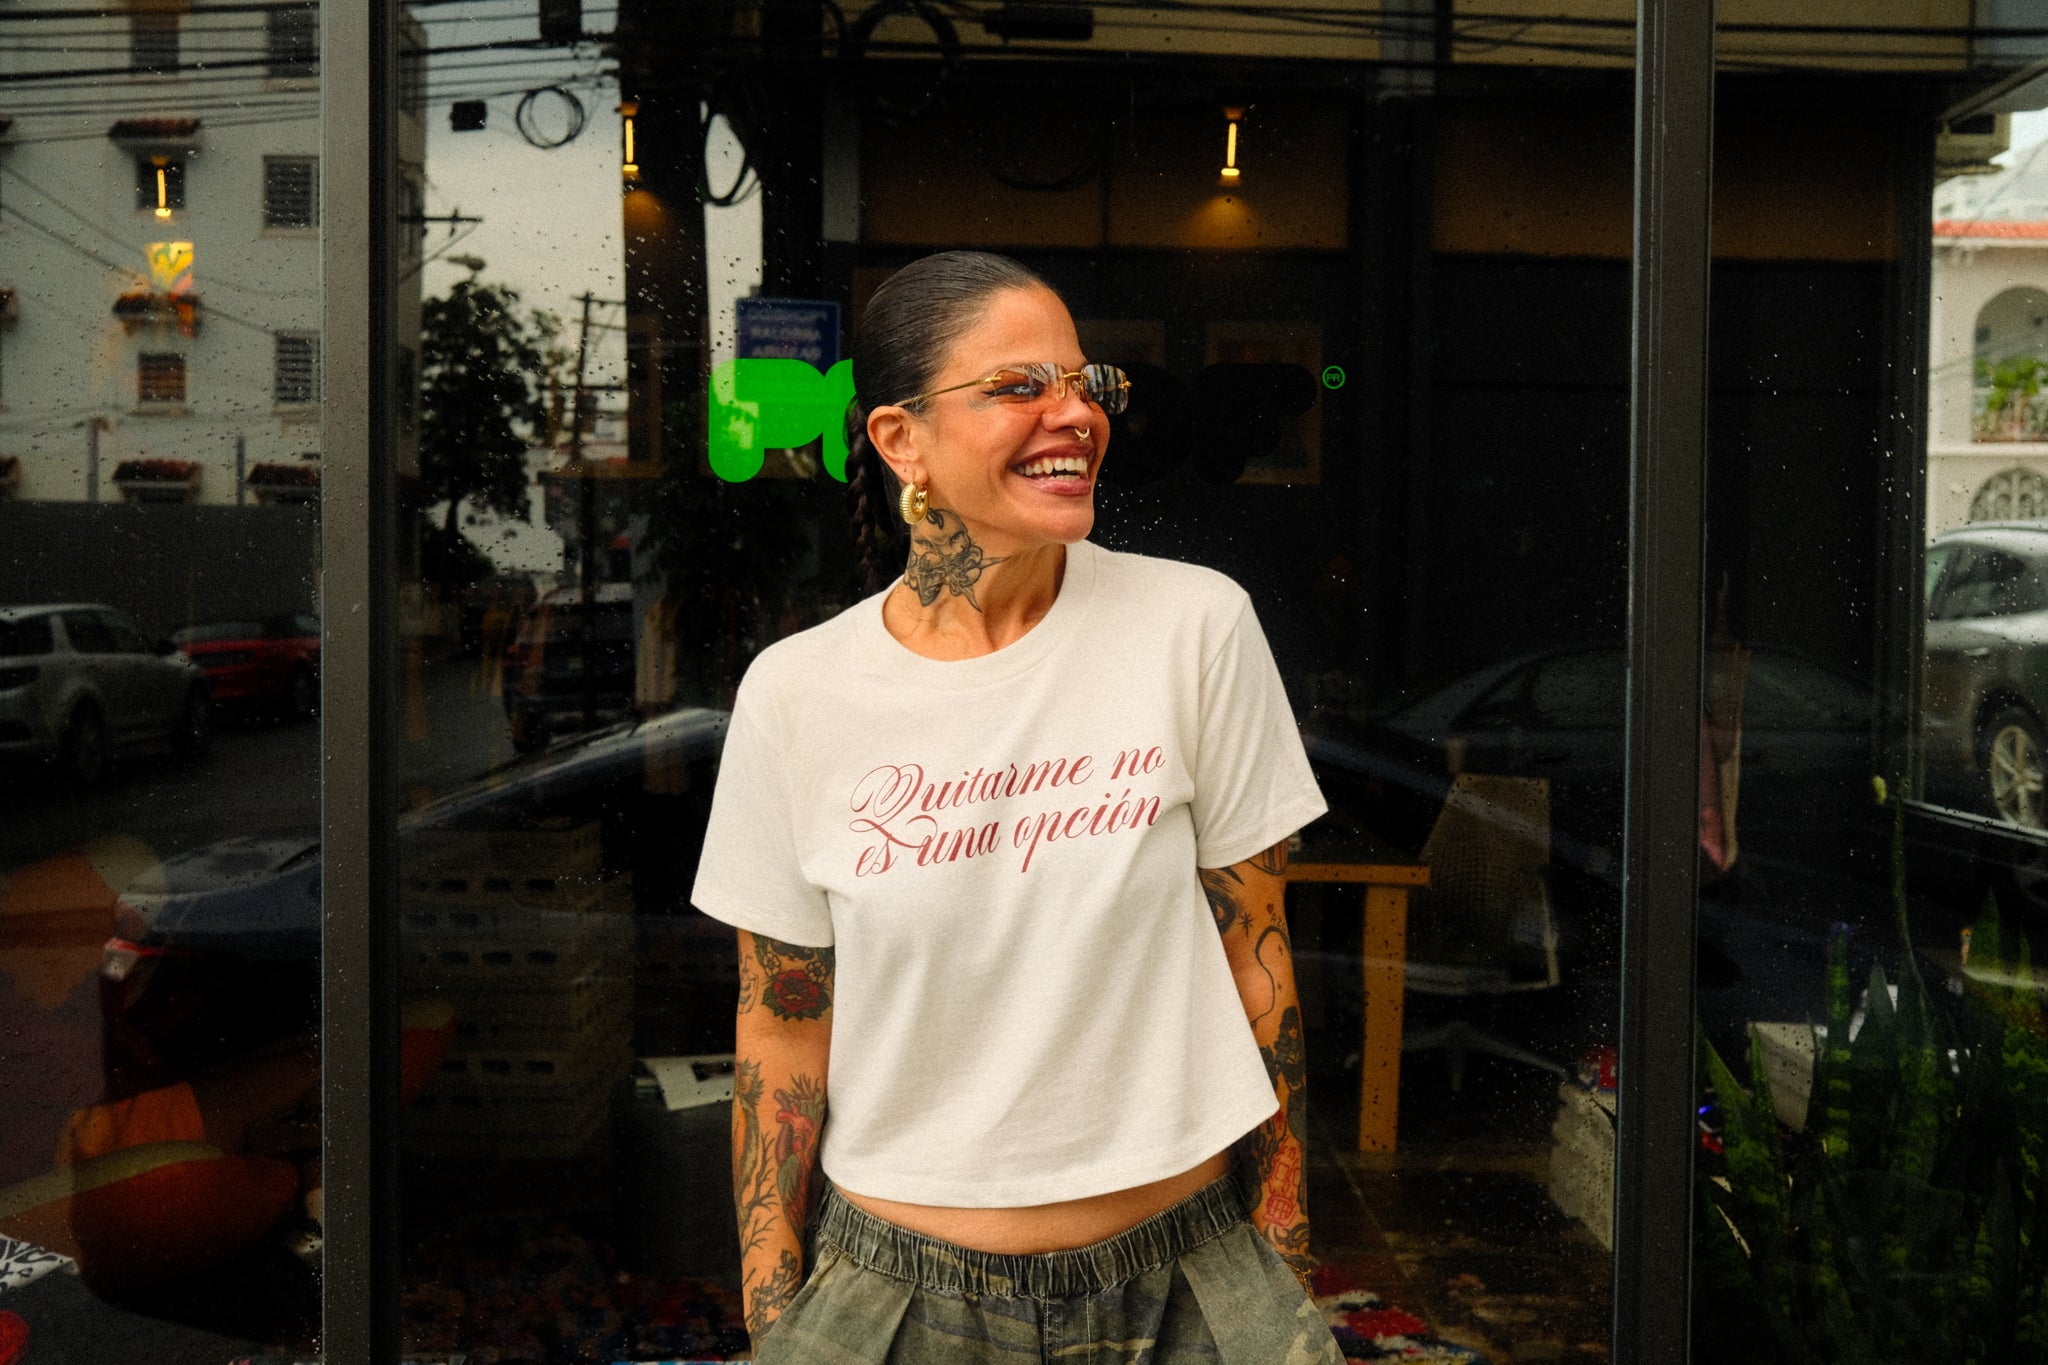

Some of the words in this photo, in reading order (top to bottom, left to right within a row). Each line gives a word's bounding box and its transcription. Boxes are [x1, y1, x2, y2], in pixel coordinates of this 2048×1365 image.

[849, 755, 1095, 846] Quitarme
[1110, 746, 1166, 780] no
[855, 838, 899, 877] es
[907, 815, 1001, 866] una
[1013, 788, 1163, 874] opción
